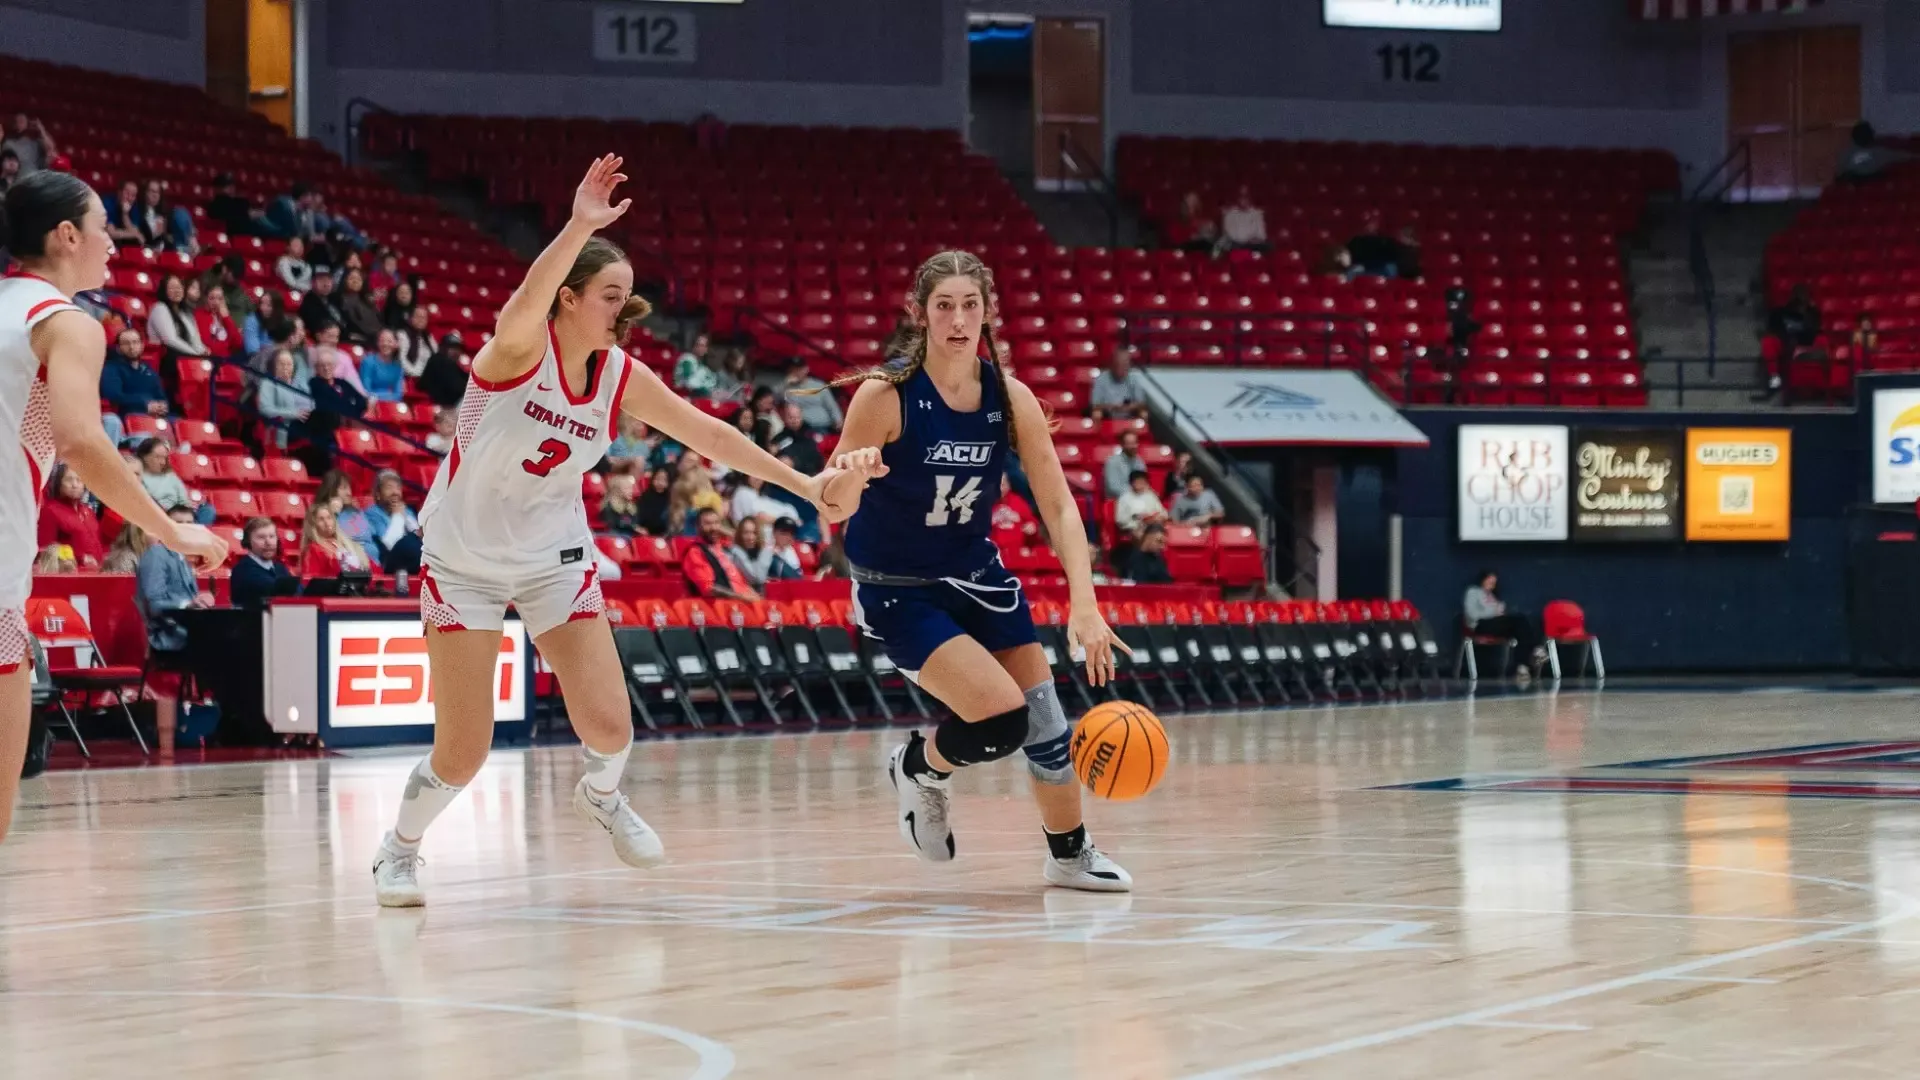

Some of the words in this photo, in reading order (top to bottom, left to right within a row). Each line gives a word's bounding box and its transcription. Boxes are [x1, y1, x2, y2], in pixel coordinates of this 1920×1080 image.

[609, 17, 679, 55] 112
[1377, 42, 1442, 82] 112
[524, 400, 567, 430] UTAH
[521, 437, 572, 478] 3
[930, 443, 991, 463] ACU
[1481, 440, 1552, 468] RIB
[1576, 441, 1672, 491] Minky
[1703, 445, 1773, 462] HUGHES
[925, 475, 983, 526] 14
[1467, 473, 1563, 505] CHOP
[1577, 476, 1667, 510] Couture
[1479, 505, 1556, 530] HOUSE
[336, 637, 514, 706] ES
